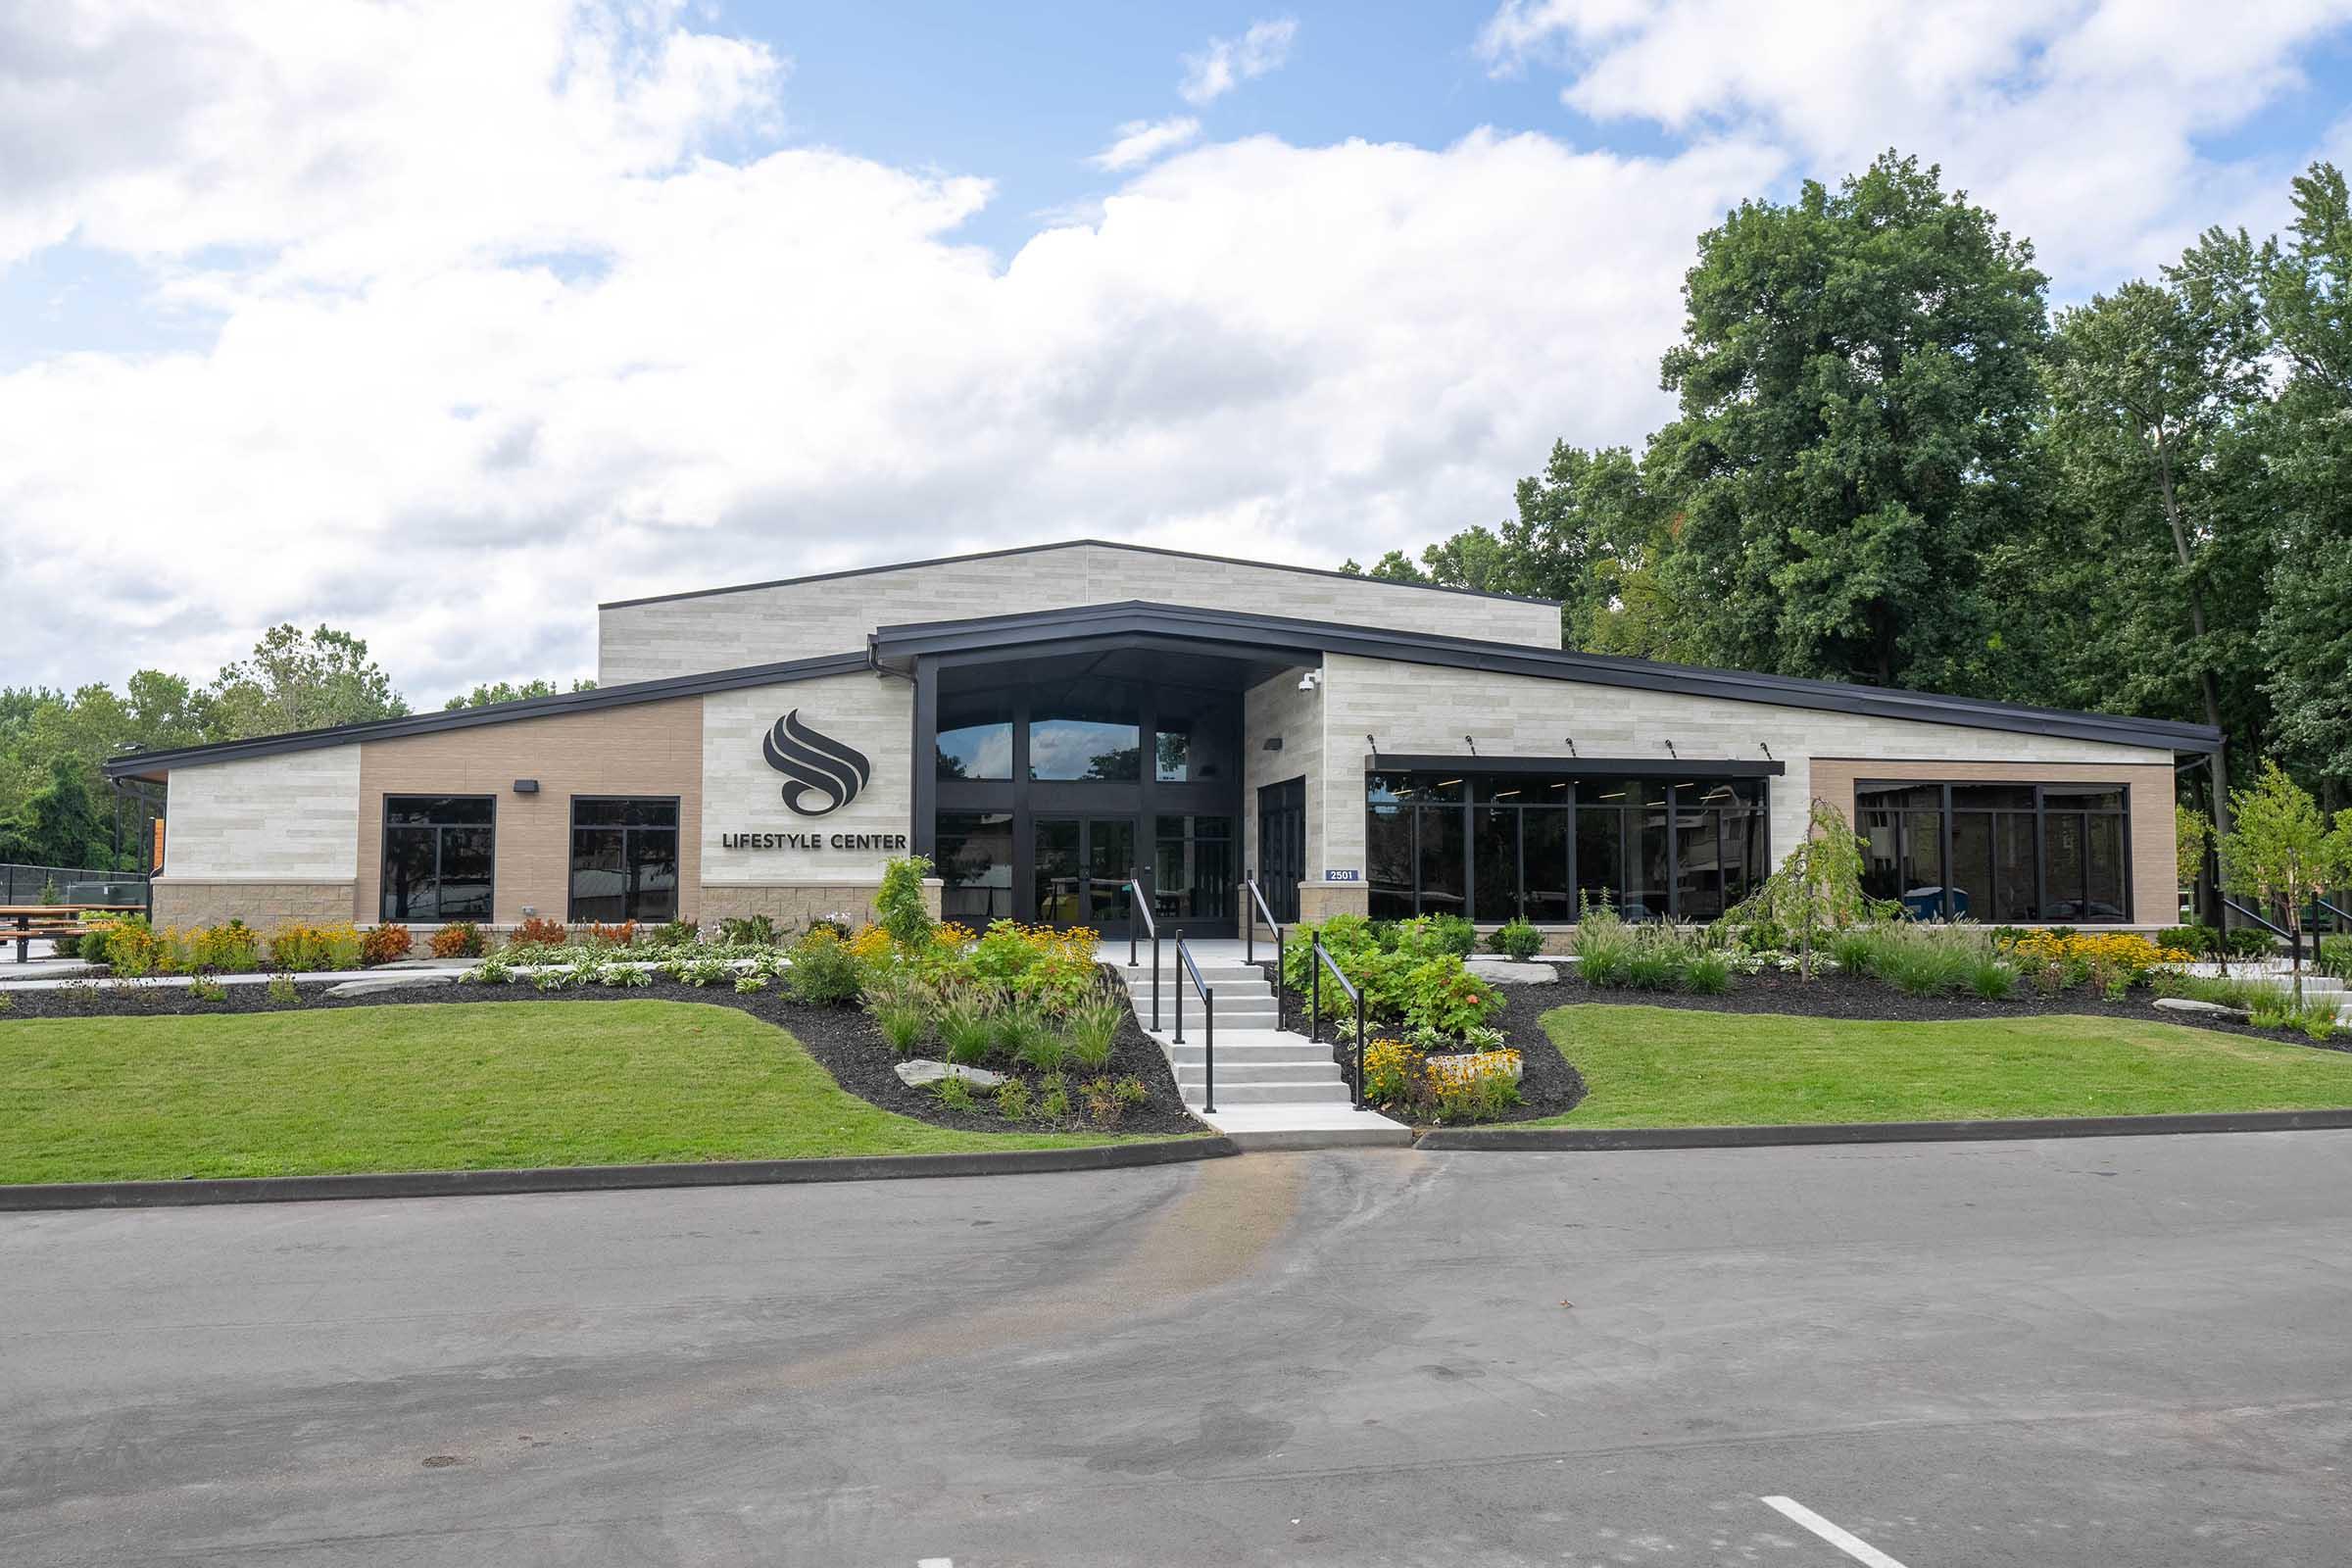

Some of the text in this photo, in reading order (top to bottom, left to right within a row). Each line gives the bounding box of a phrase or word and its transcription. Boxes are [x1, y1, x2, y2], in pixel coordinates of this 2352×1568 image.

[722, 833, 906, 849] LIFESTYLE CENTER
[1331, 871, 1352, 880] 2501
